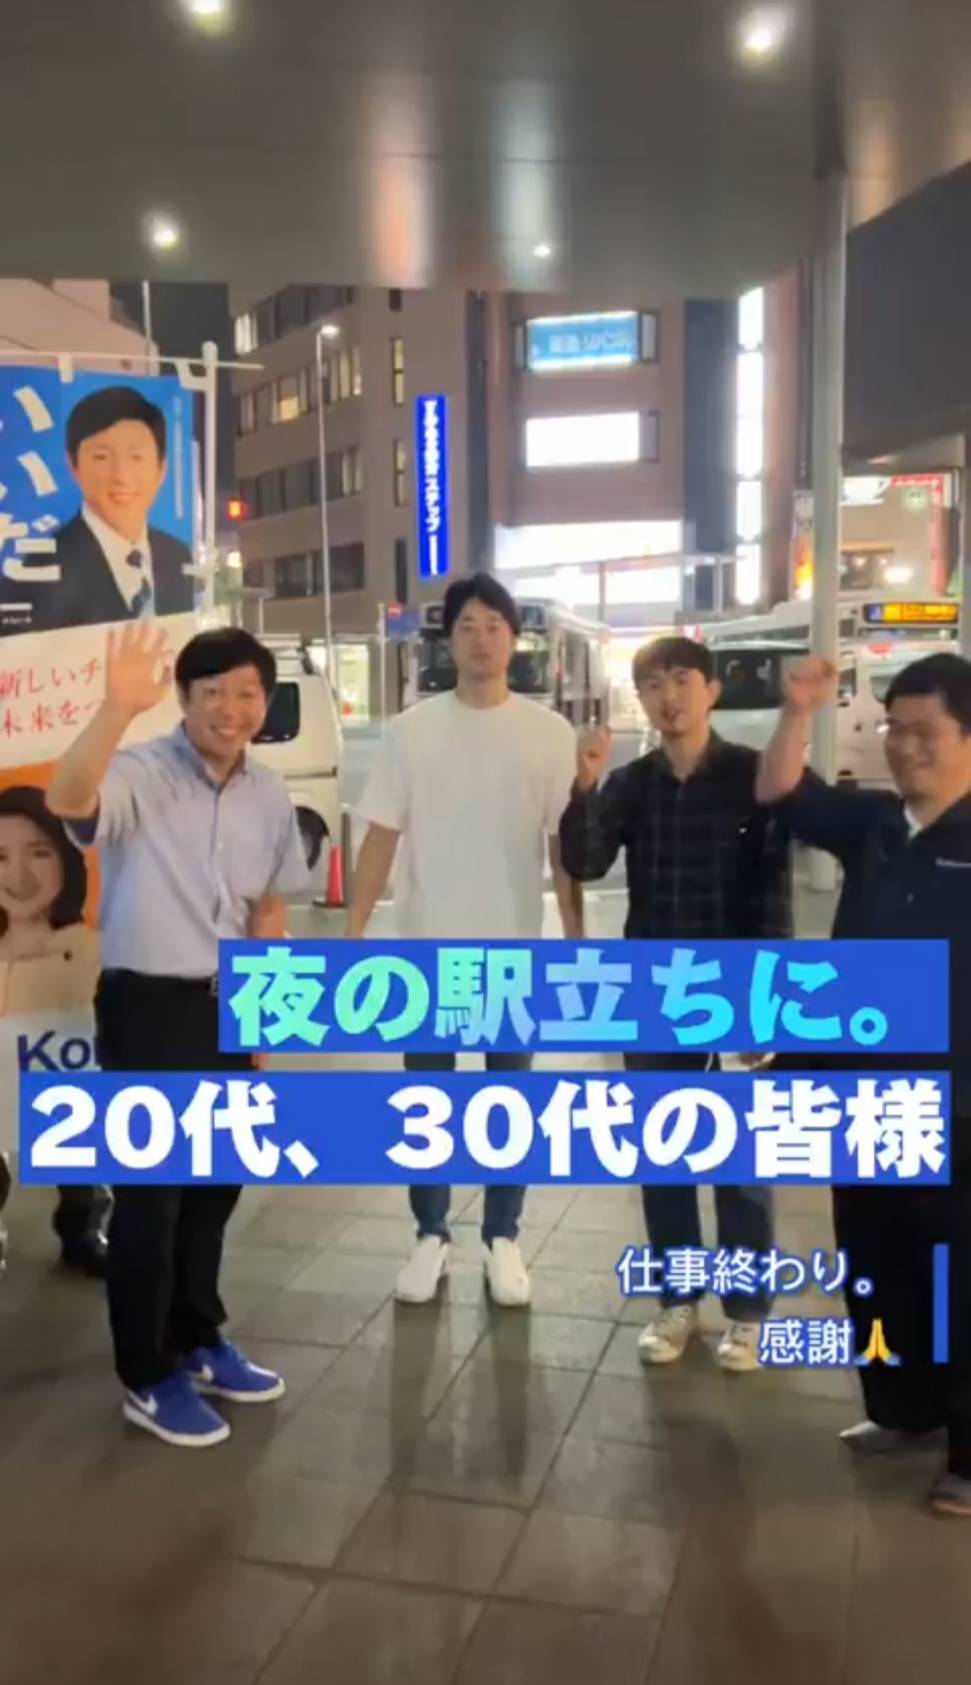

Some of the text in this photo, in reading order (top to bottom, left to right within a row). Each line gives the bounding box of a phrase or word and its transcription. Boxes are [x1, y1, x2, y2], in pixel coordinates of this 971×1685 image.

[0, 700, 99, 738] 未来を
[17, 1029, 99, 1072] Ko
